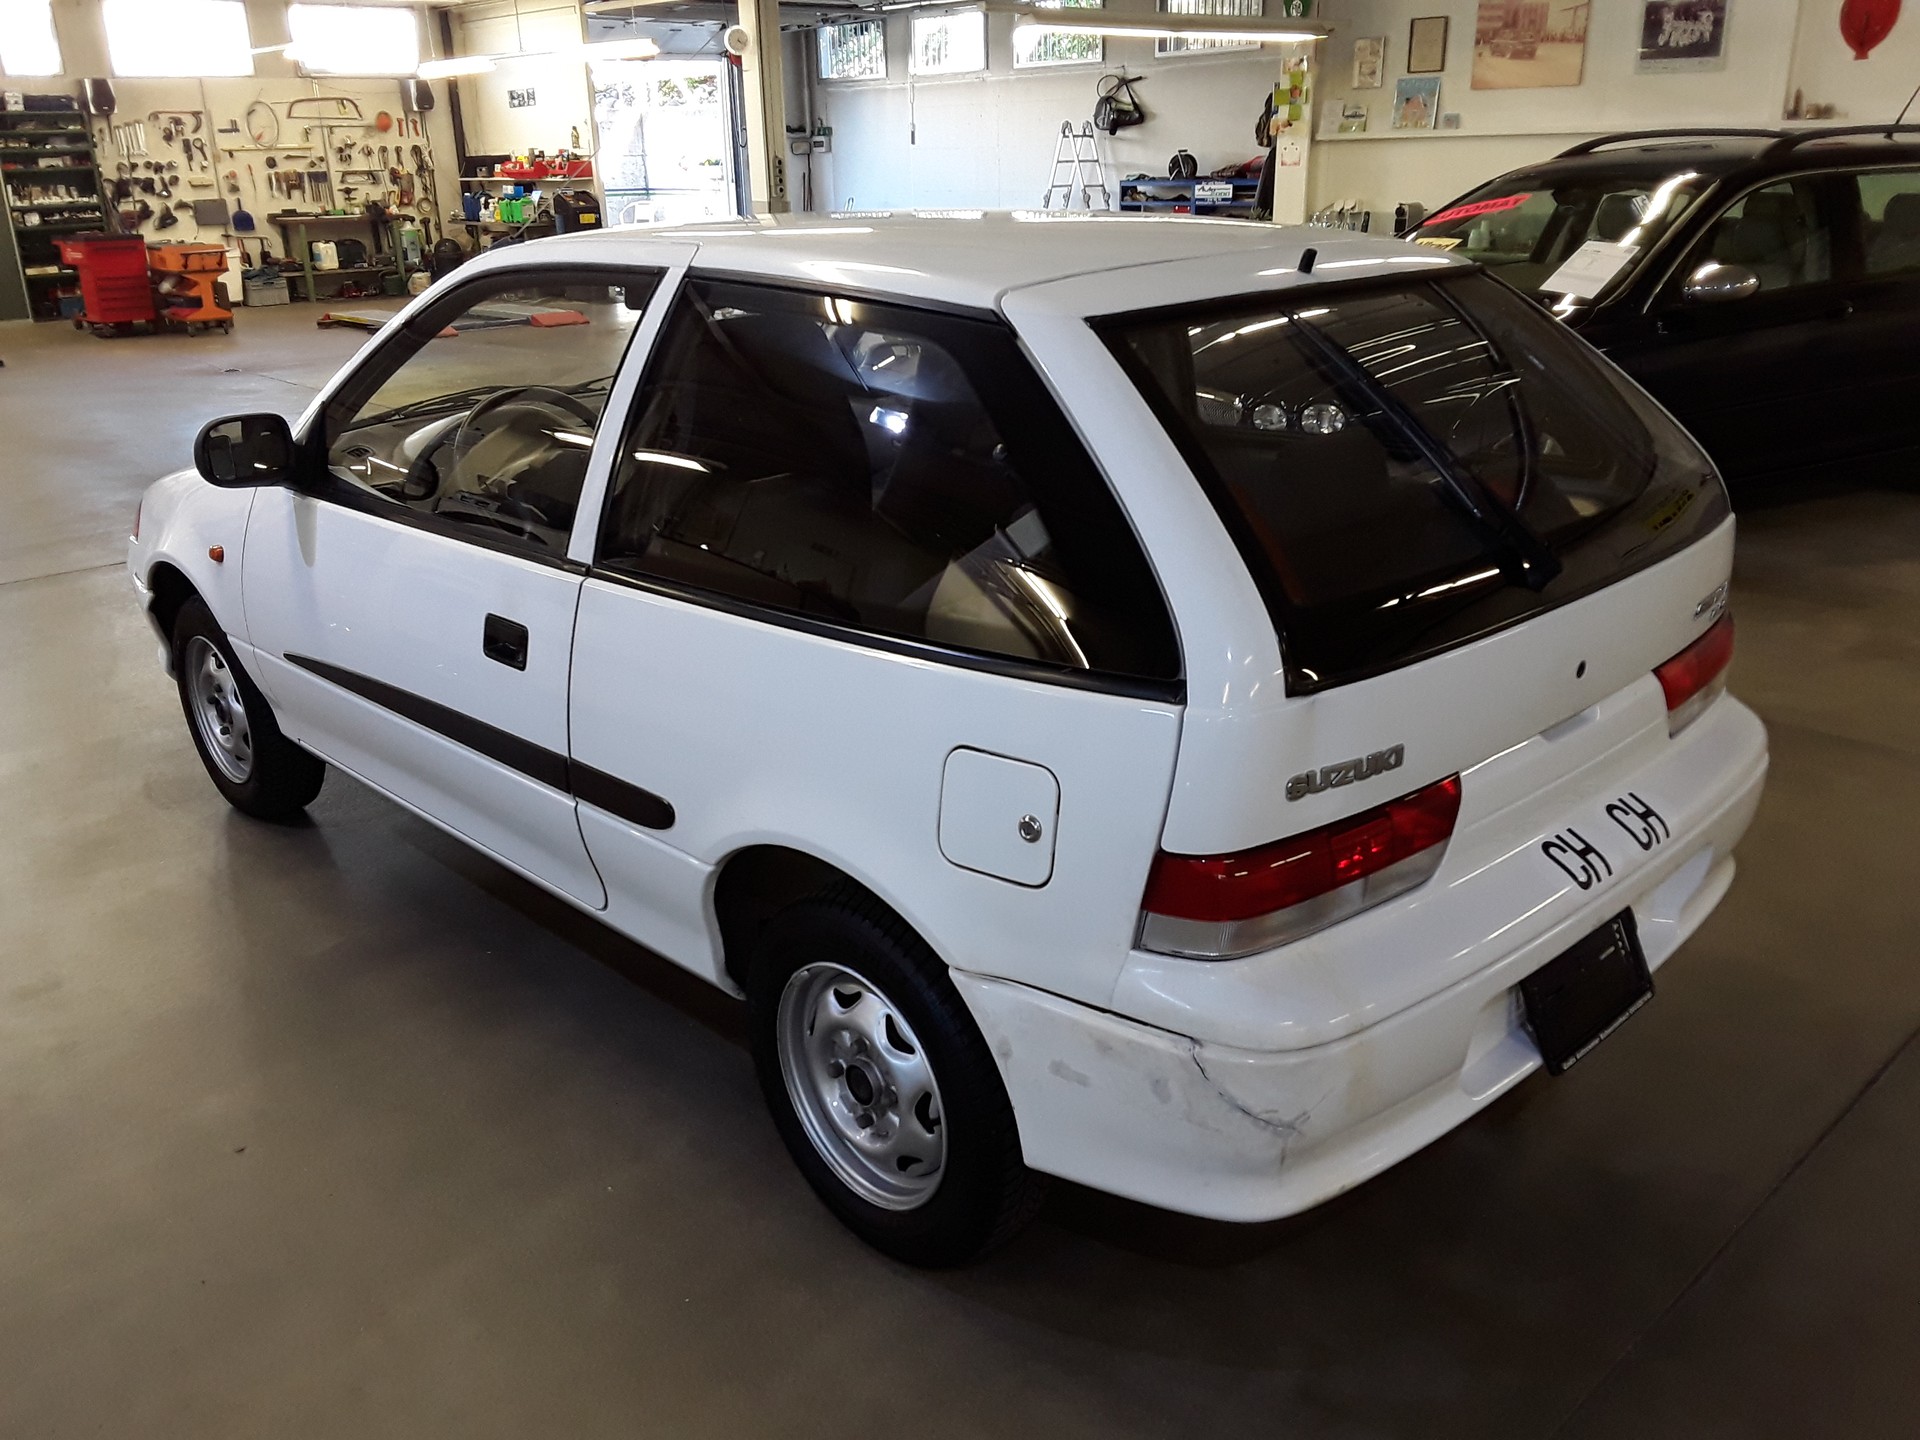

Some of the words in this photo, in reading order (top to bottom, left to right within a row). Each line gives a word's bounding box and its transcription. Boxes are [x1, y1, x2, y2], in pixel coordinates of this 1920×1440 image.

[1285, 743, 1405, 801] SUZUKI
[1541, 827, 1613, 890] CH
[1605, 792, 1670, 851] CH
